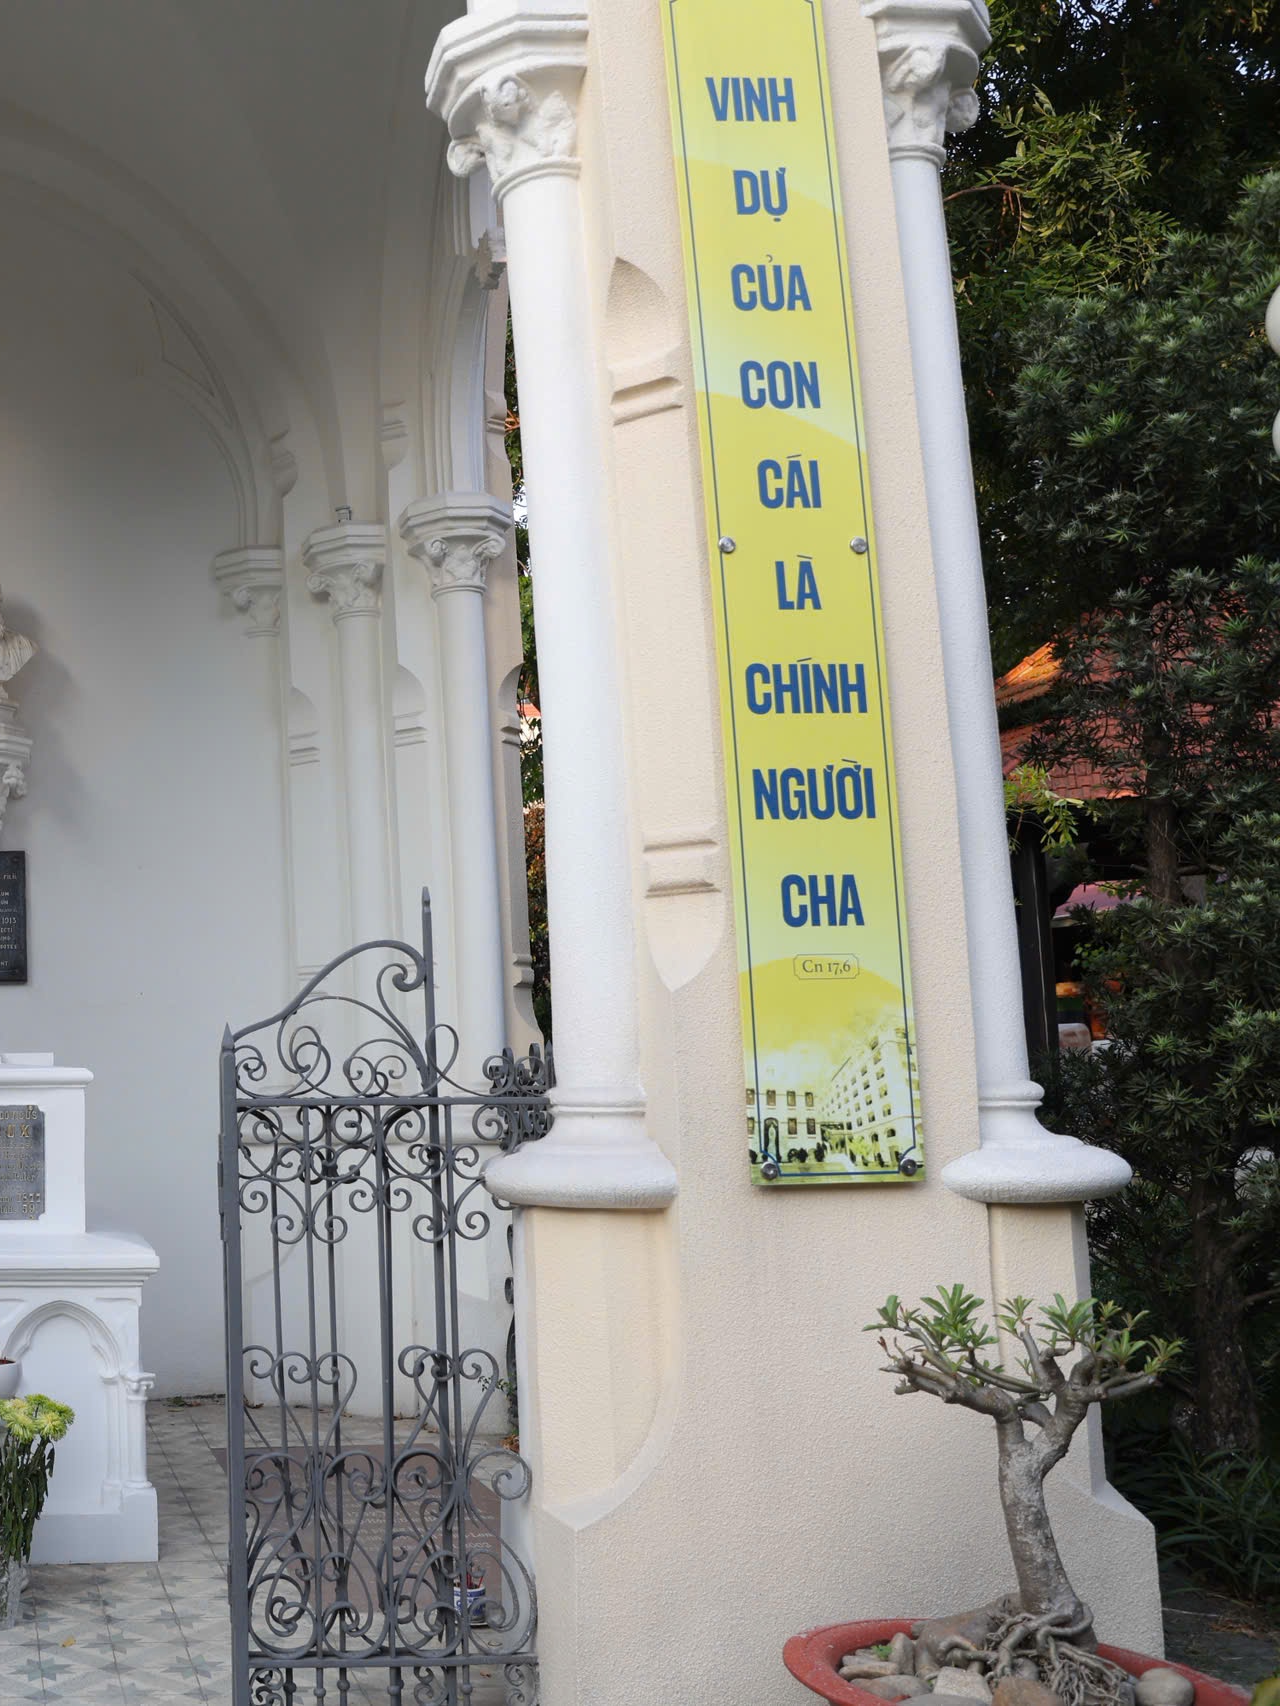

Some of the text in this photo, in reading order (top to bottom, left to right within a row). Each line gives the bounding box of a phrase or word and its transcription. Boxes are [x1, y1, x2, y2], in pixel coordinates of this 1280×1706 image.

[705, 77, 797, 122] VINH
[733, 167, 788, 222] DỰ
[731, 255, 812, 311] CỦA
[739, 360, 822, 409] CON
[757, 454, 822, 509] CÁI
[775, 555, 822, 610] LÀ
[745, 658, 868, 715] CHÍNH
[752, 758, 876, 820] NGƯỜI
[780, 873, 865, 928] CHA
[802, 959, 851, 975] Cn 17,6
